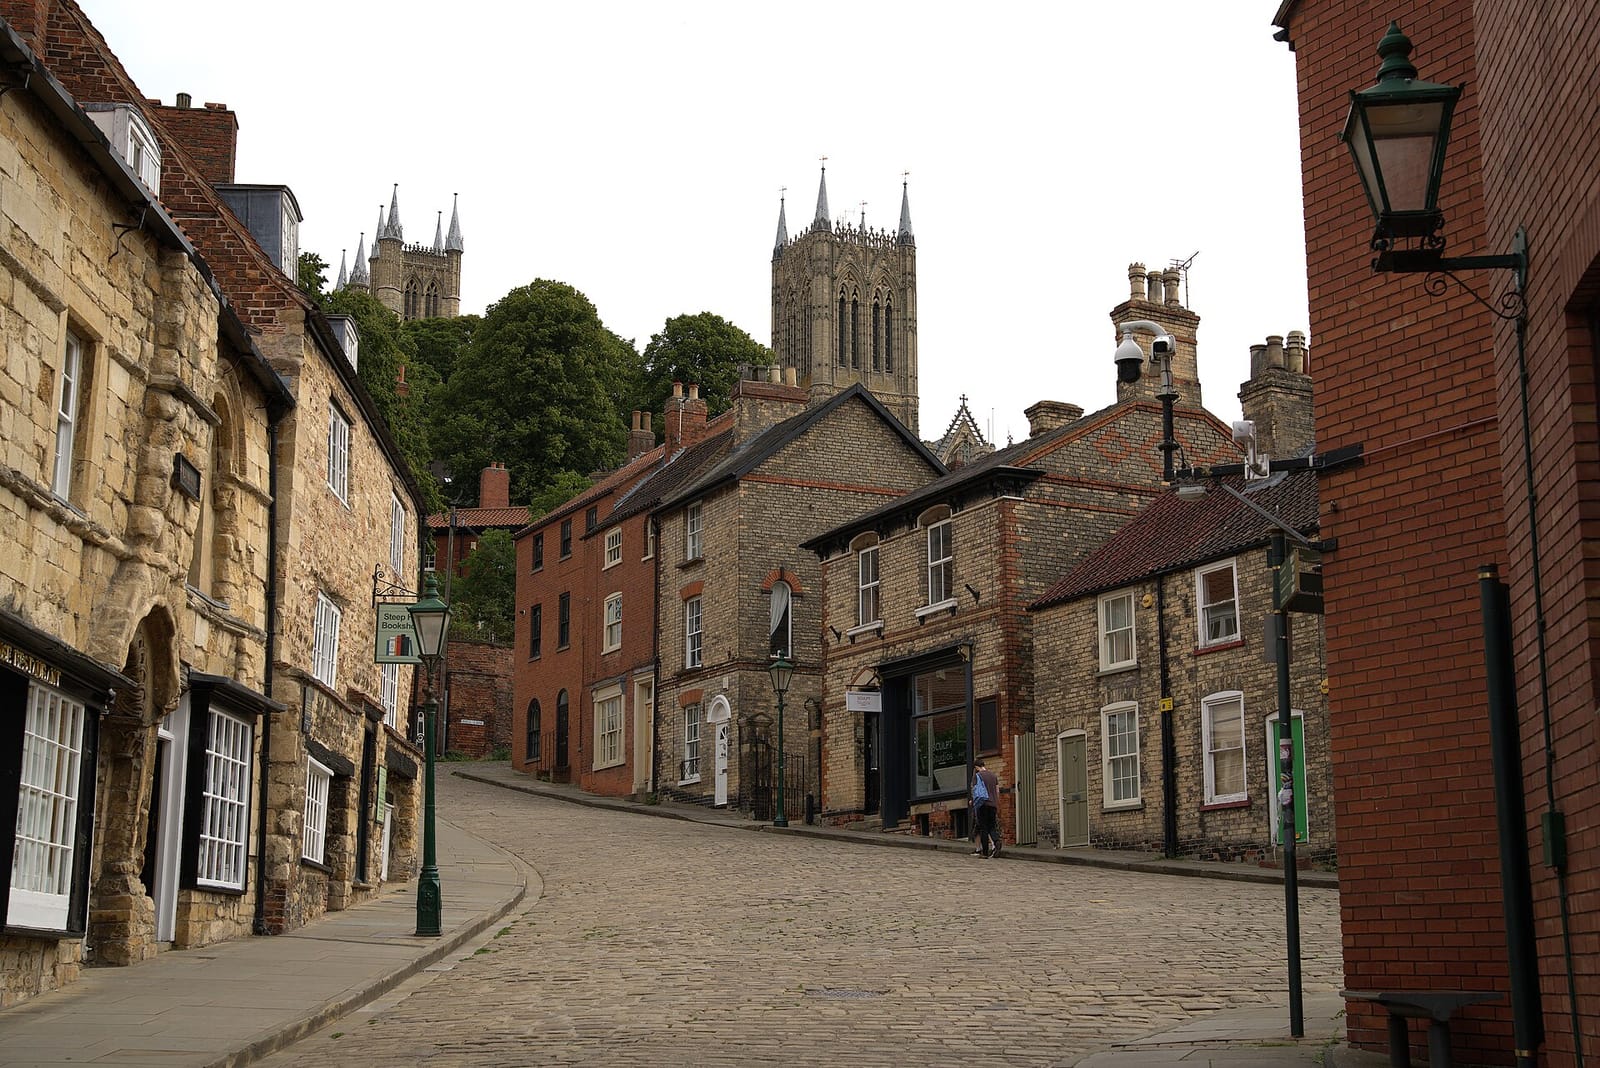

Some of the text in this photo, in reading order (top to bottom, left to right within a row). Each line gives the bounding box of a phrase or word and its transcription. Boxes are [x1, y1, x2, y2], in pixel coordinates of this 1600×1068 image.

[383, 612, 406, 622] Steep
[381, 621, 415, 630] Booksho
[13, 649, 61, 687] RESTAURANT
